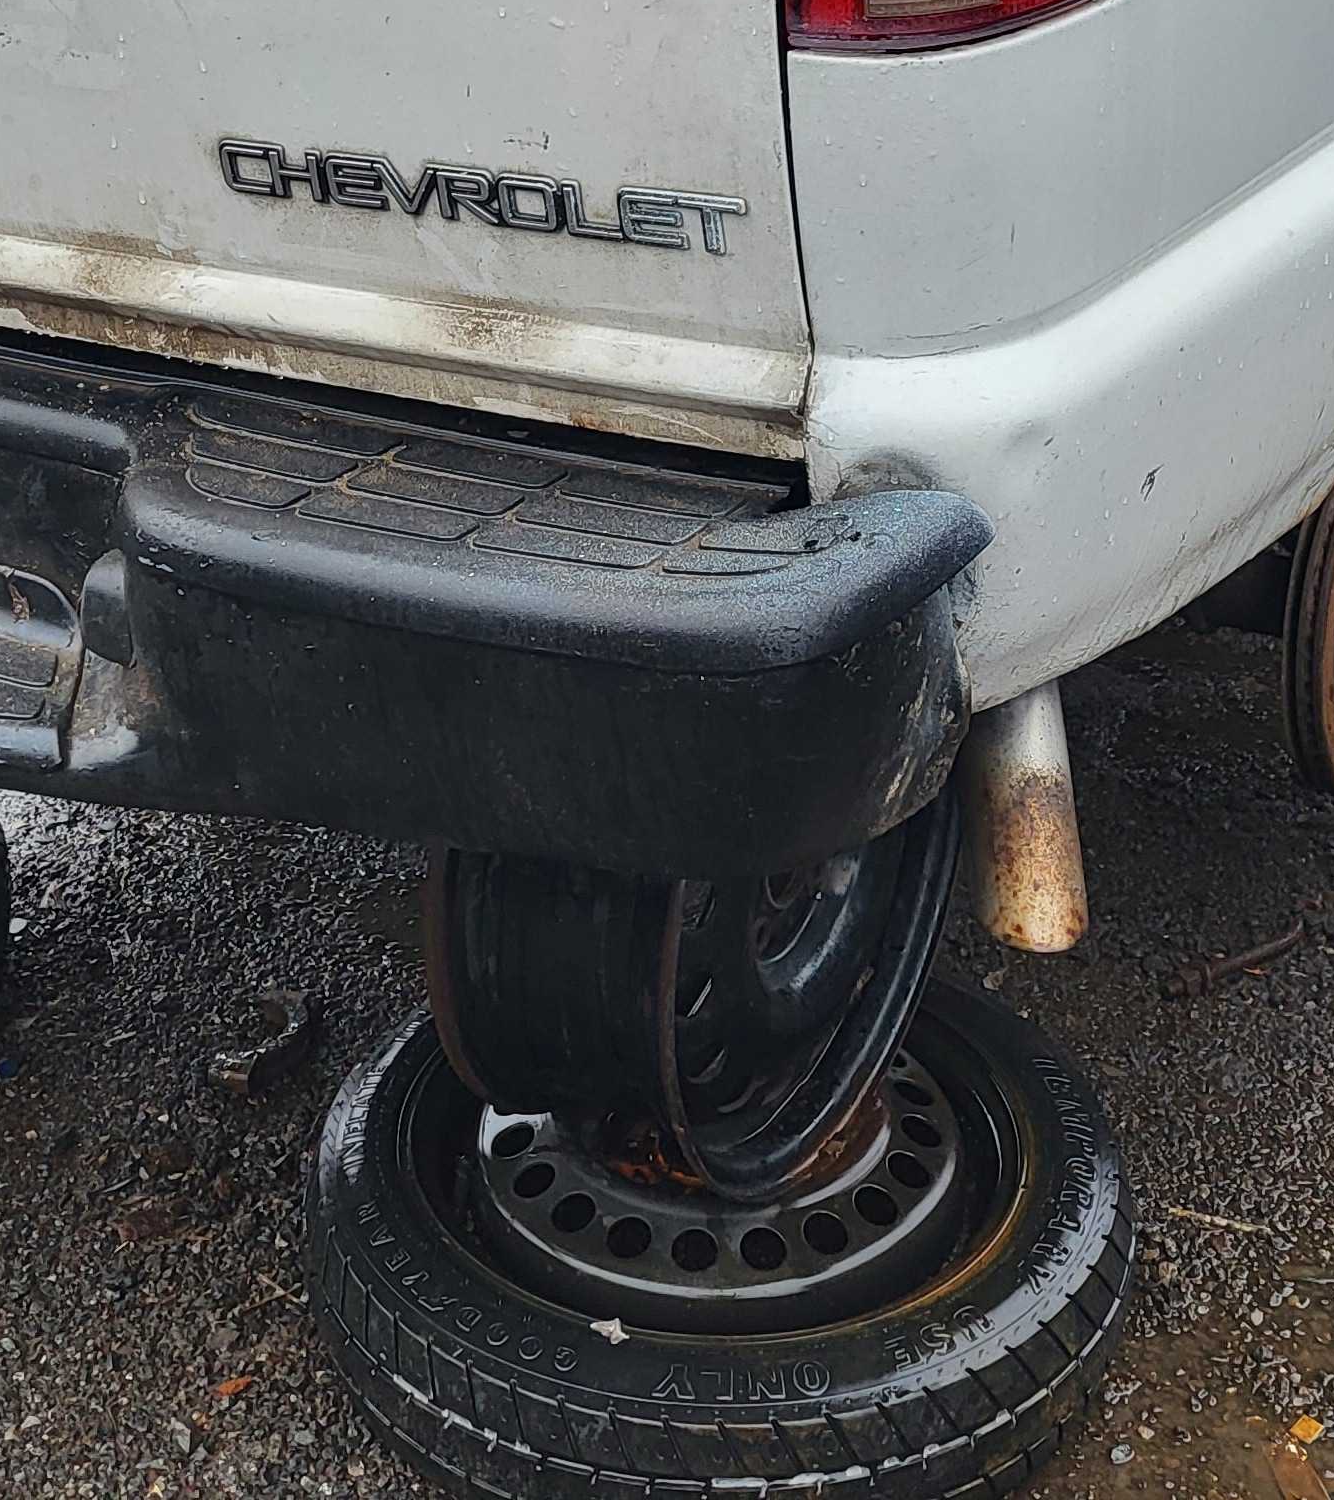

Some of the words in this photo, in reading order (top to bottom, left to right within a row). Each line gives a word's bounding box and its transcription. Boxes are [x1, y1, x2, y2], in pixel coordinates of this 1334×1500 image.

[218, 138, 748, 256] CHEVROLET
[357, 1199, 580, 1373] GOODYEAR
[650, 1361, 830, 1400] ONLY
[884, 1304, 996, 1373] USE
